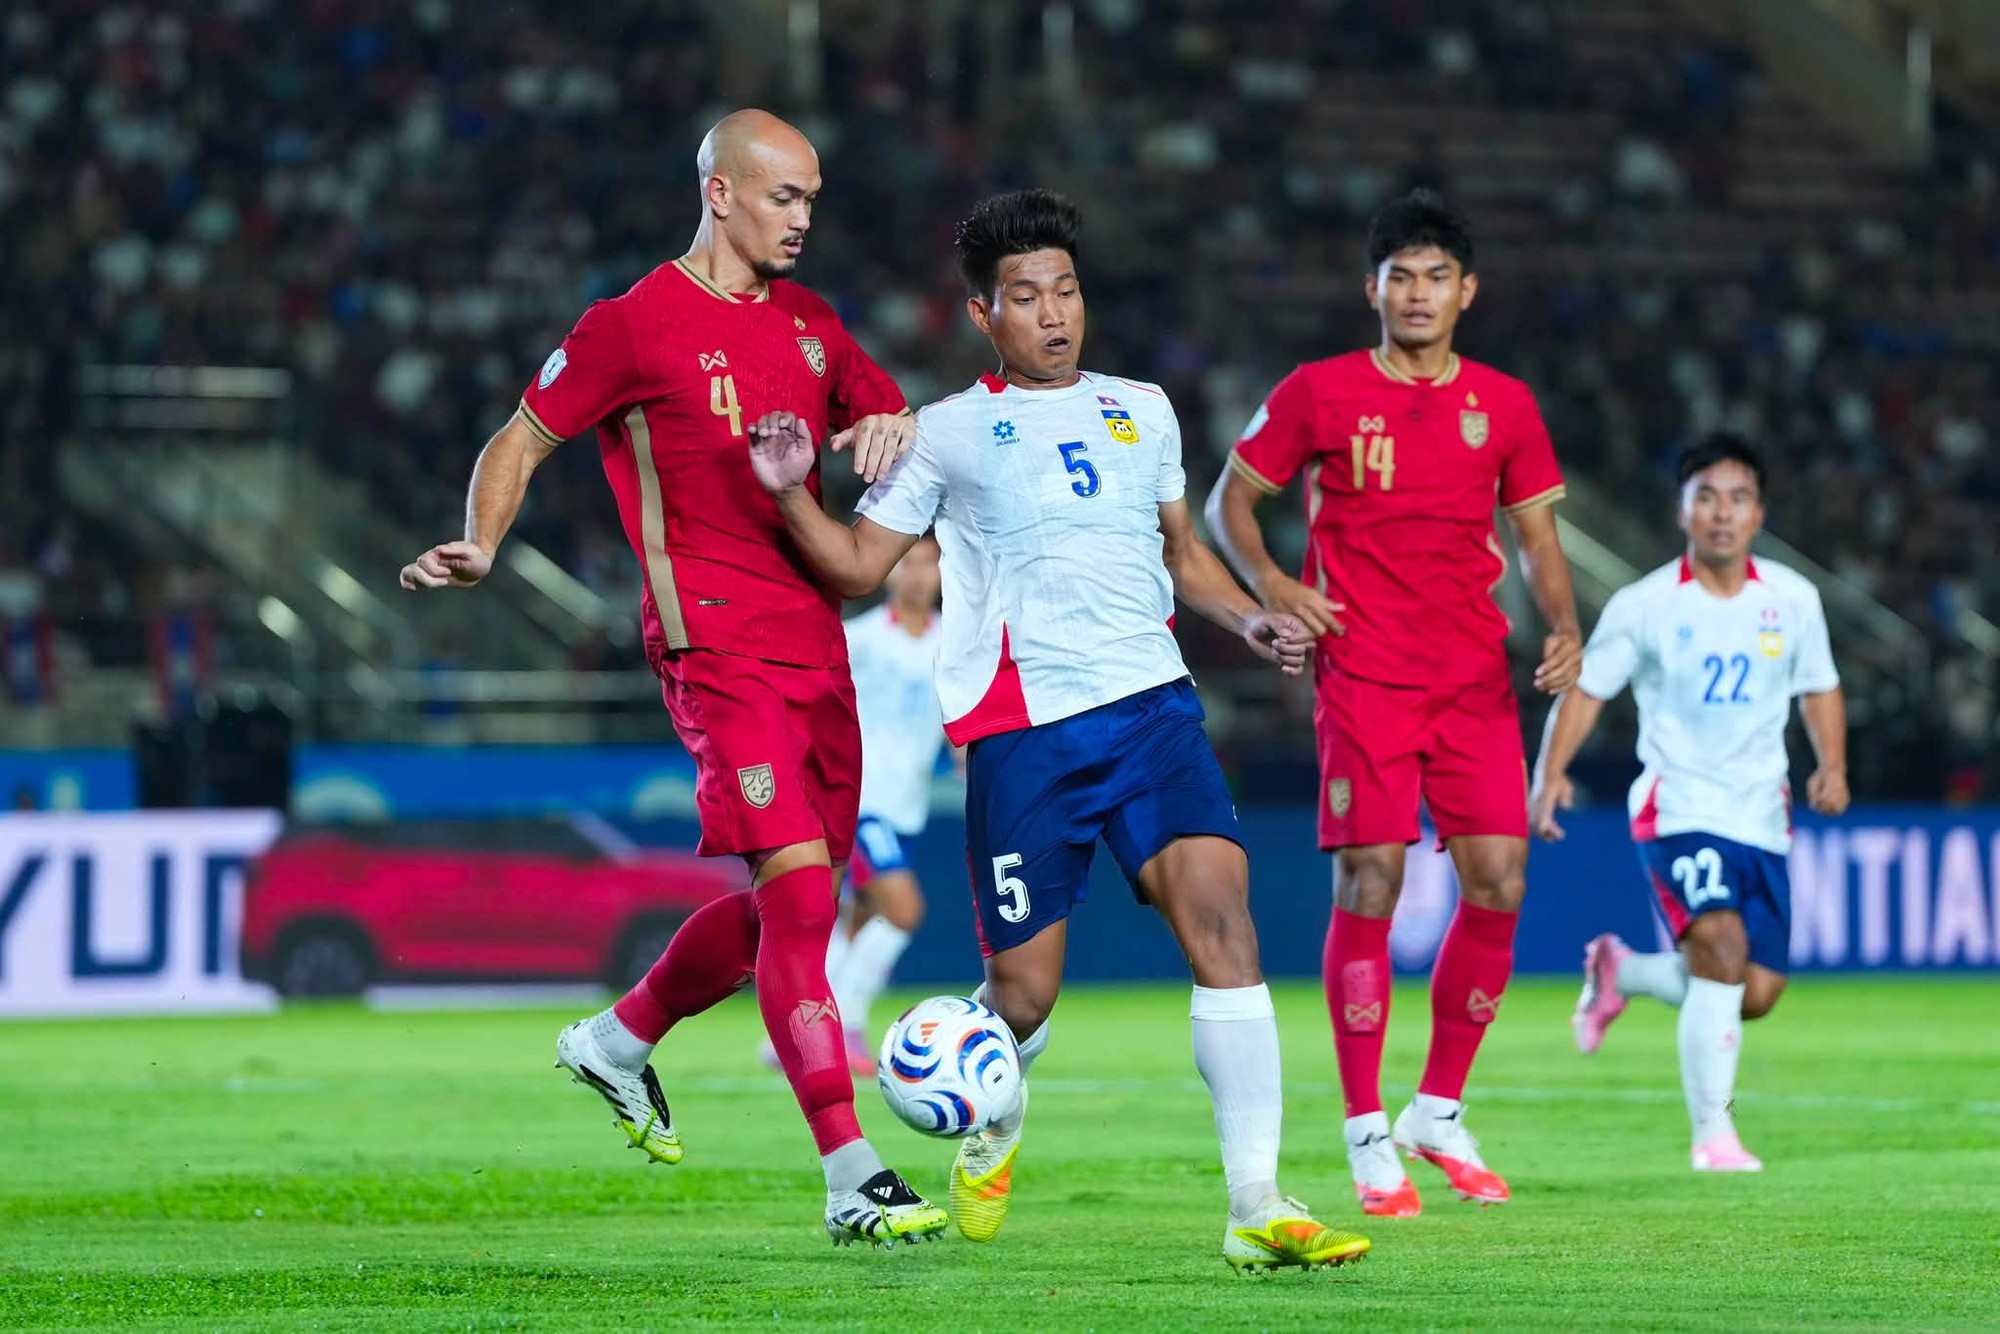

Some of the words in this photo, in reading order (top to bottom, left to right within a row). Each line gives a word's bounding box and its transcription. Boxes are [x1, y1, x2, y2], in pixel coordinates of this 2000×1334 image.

[711, 374, 743, 436] 4
[1057, 440, 1101, 498] 5
[1350, 434, 1396, 491] 14
[1703, 653, 1750, 703] 22
[992, 852, 1031, 923] 5
[1671, 846, 1730, 909] 22
[1789, 826, 2000, 966] NTIA
